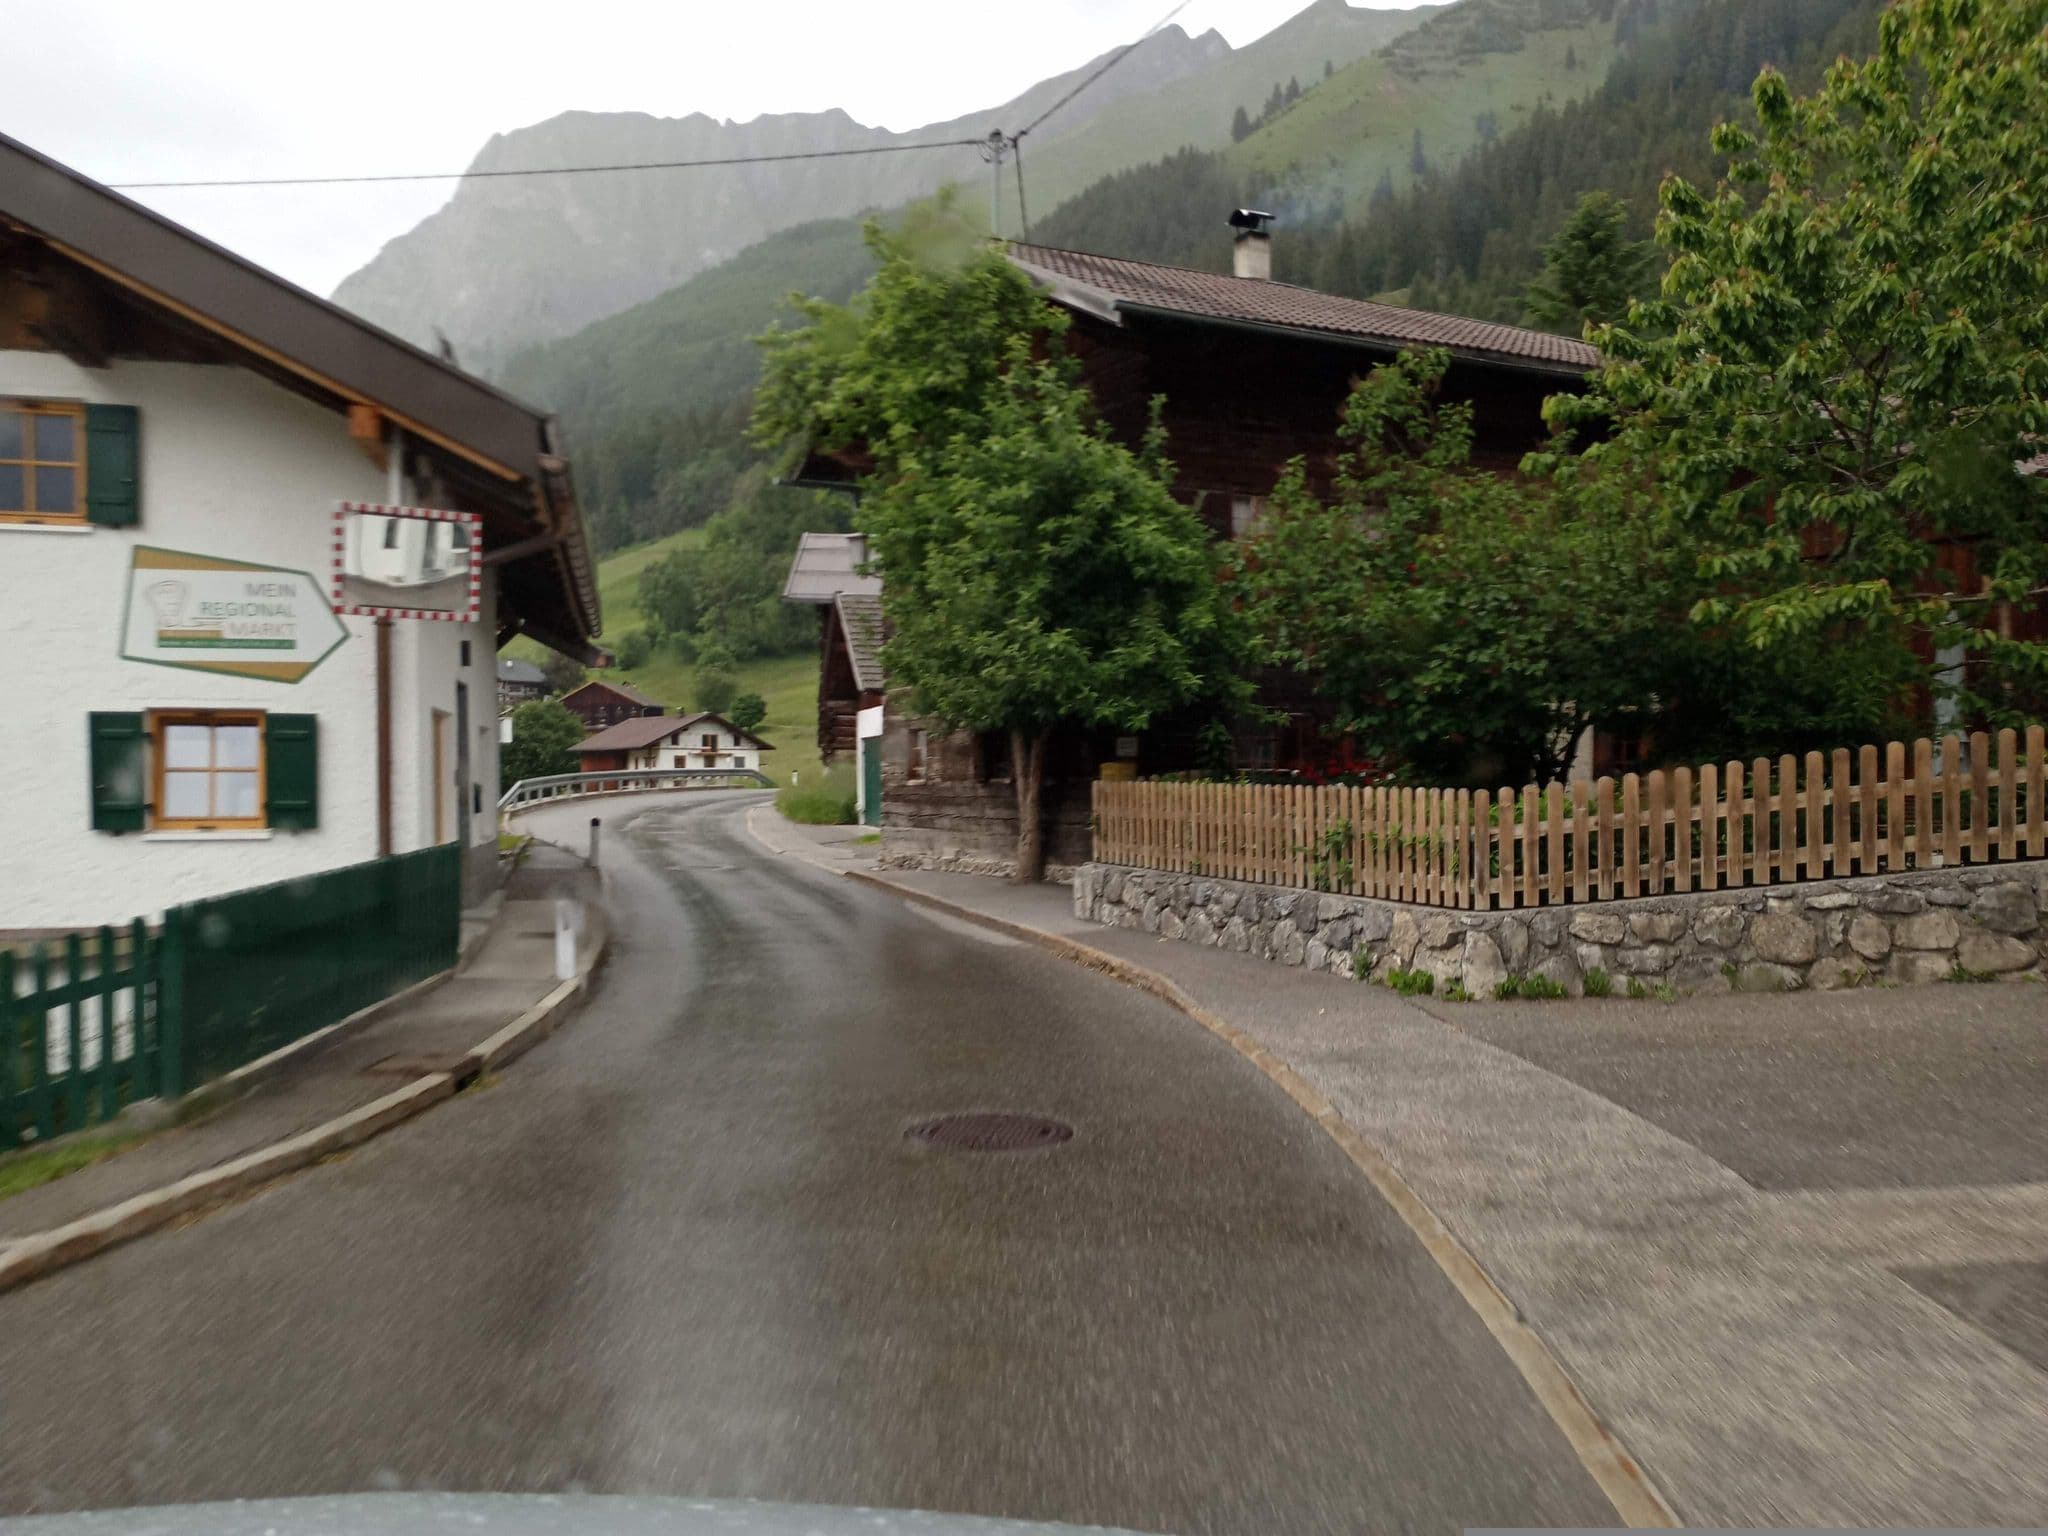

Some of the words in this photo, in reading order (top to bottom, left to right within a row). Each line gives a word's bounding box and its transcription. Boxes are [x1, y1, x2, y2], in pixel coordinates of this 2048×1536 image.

[246, 583, 297, 597] MEIN
[200, 601, 297, 617] REGIONAL
[227, 622, 297, 636] MARKT
